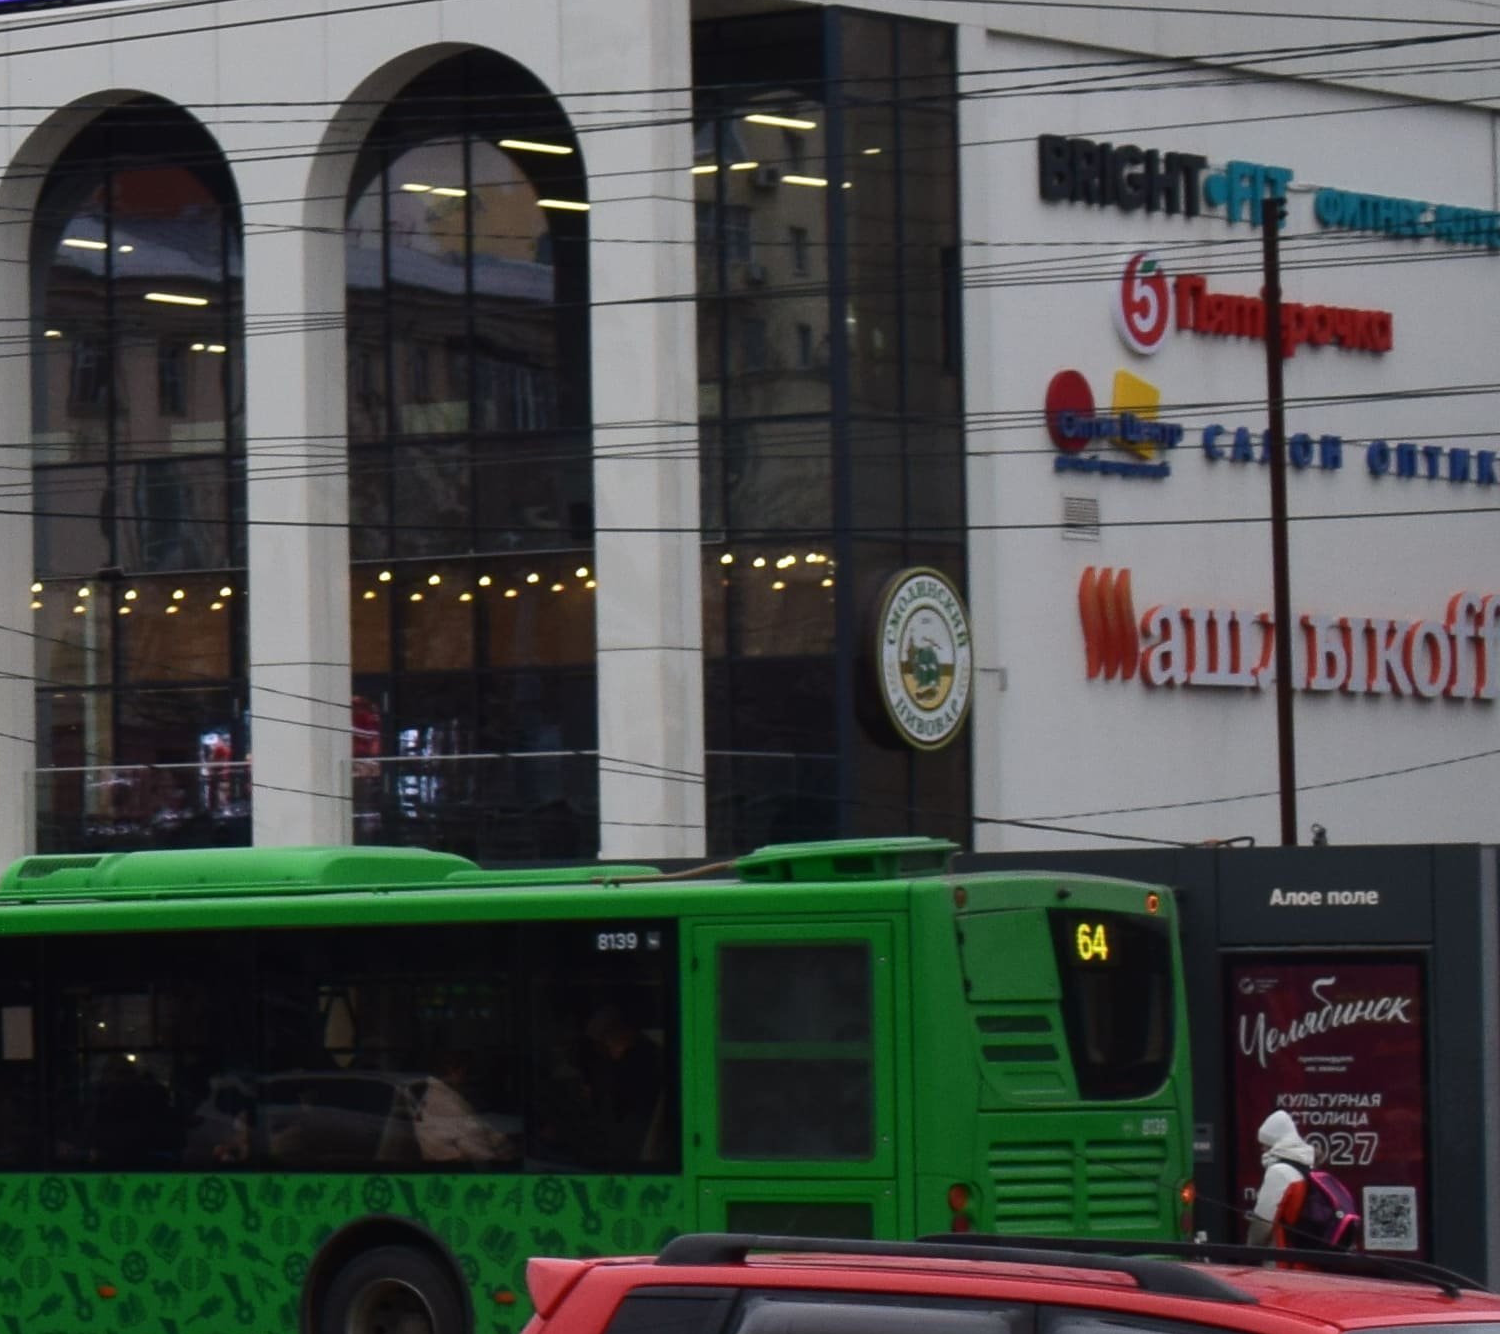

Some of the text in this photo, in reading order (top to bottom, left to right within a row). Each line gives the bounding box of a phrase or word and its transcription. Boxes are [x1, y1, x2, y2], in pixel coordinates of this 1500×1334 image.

[1038, 134, 1208, 217] BRIGHT
[1175, 274, 1394, 358] Пятрочка
[1269, 887, 1379, 906] Алое поле
[596, 933, 638, 951] 8139
[1076, 923, 1109, 962] 64
[1238, 976, 1412, 1068] Челябинск
[1276, 1093, 1383, 1108] КУЛЬТУРНАЯ
